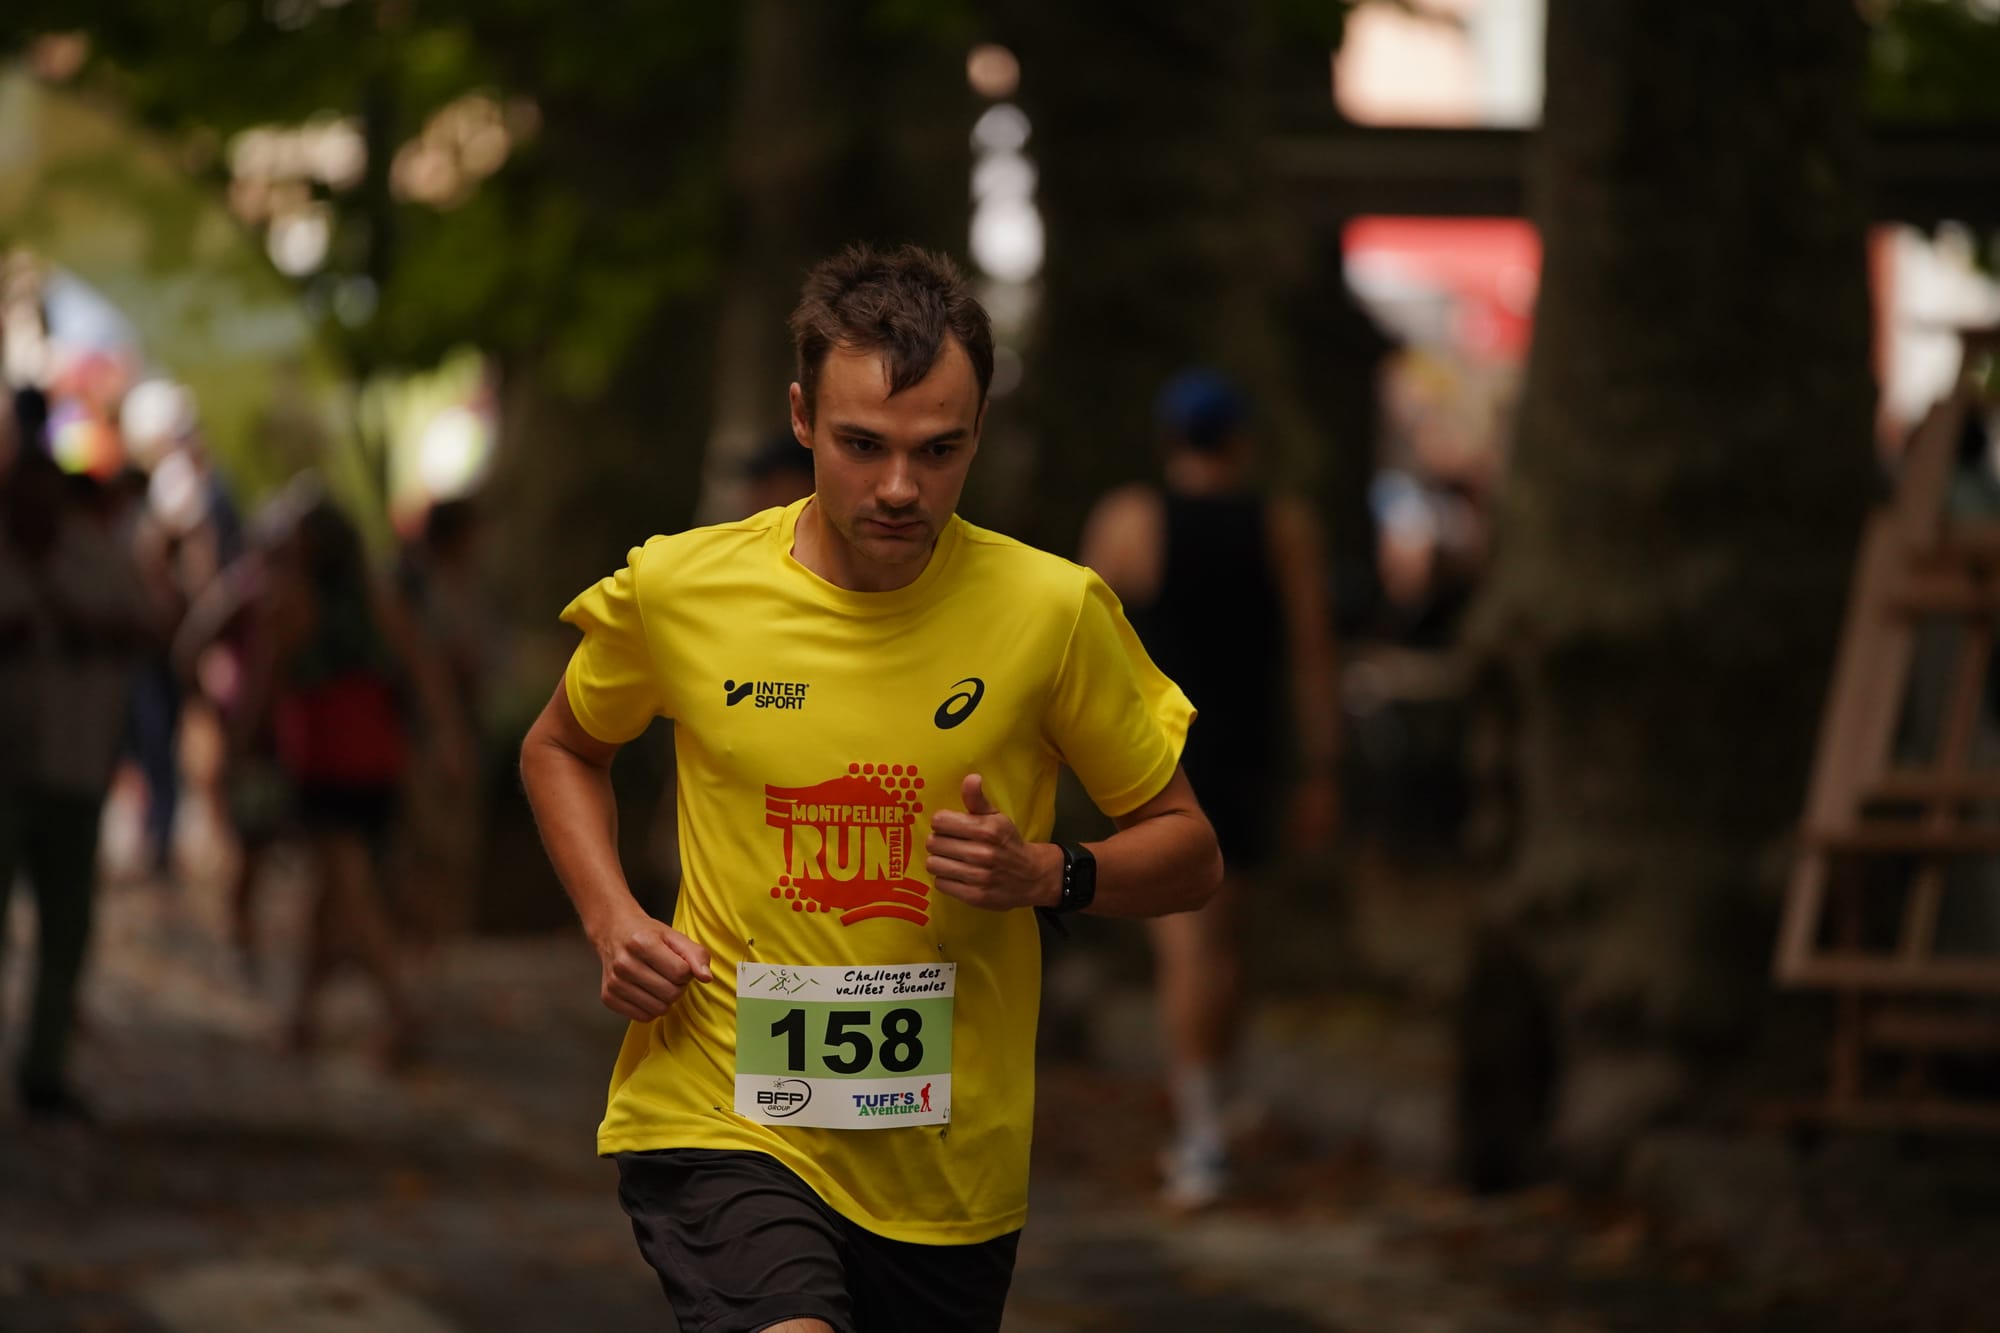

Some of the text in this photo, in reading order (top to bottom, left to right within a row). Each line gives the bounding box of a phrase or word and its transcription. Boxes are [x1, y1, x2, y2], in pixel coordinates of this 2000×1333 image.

[755, 695, 805, 709] SPORT
[791, 803, 905, 824] MONTPELLIER
[791, 824, 891, 882] RUN
[889, 828, 902, 879] FESTIVAL
[844, 968, 941, 985] Challenge des
[836, 981, 947, 996] vallées cévenoles
[770, 1007, 924, 1075] 158
[757, 1091, 804, 1105] BFP
[852, 1092, 915, 1108] TUFF'S
[858, 1103, 920, 1117] Aventure
